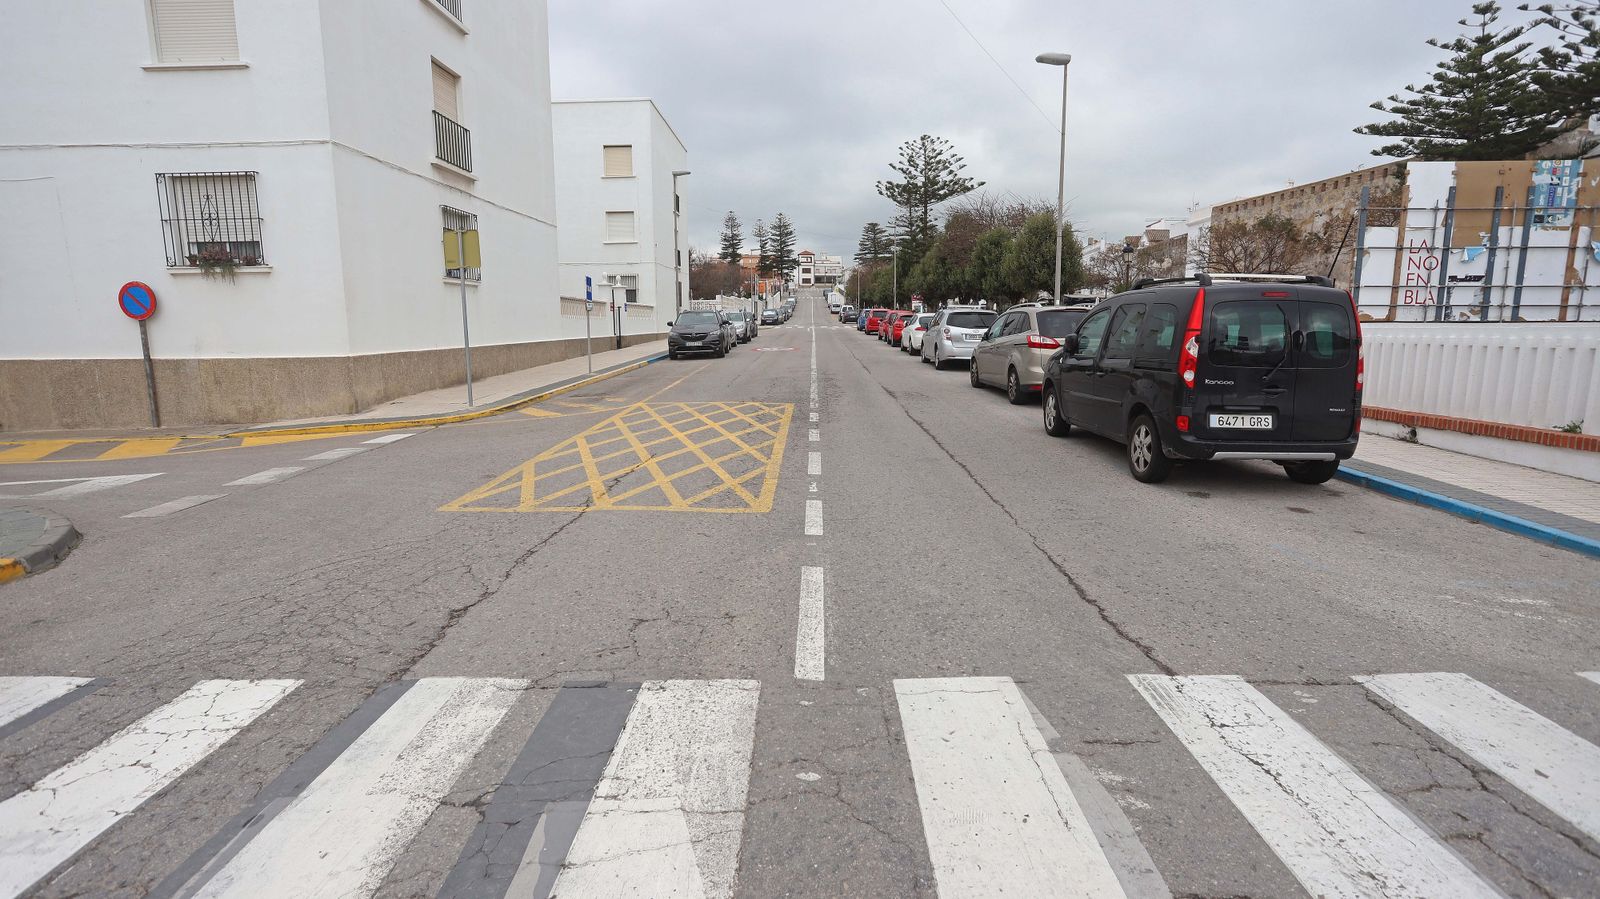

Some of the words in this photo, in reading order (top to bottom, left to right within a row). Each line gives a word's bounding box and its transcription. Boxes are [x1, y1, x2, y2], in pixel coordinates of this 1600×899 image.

[1410, 239, 1430, 254] LA
[1408, 255, 1439, 271] NO
[1404, 289, 1435, 304] BLA
[1217, 416, 1246, 427] 6471
[1249, 416, 1271, 428] GRS
